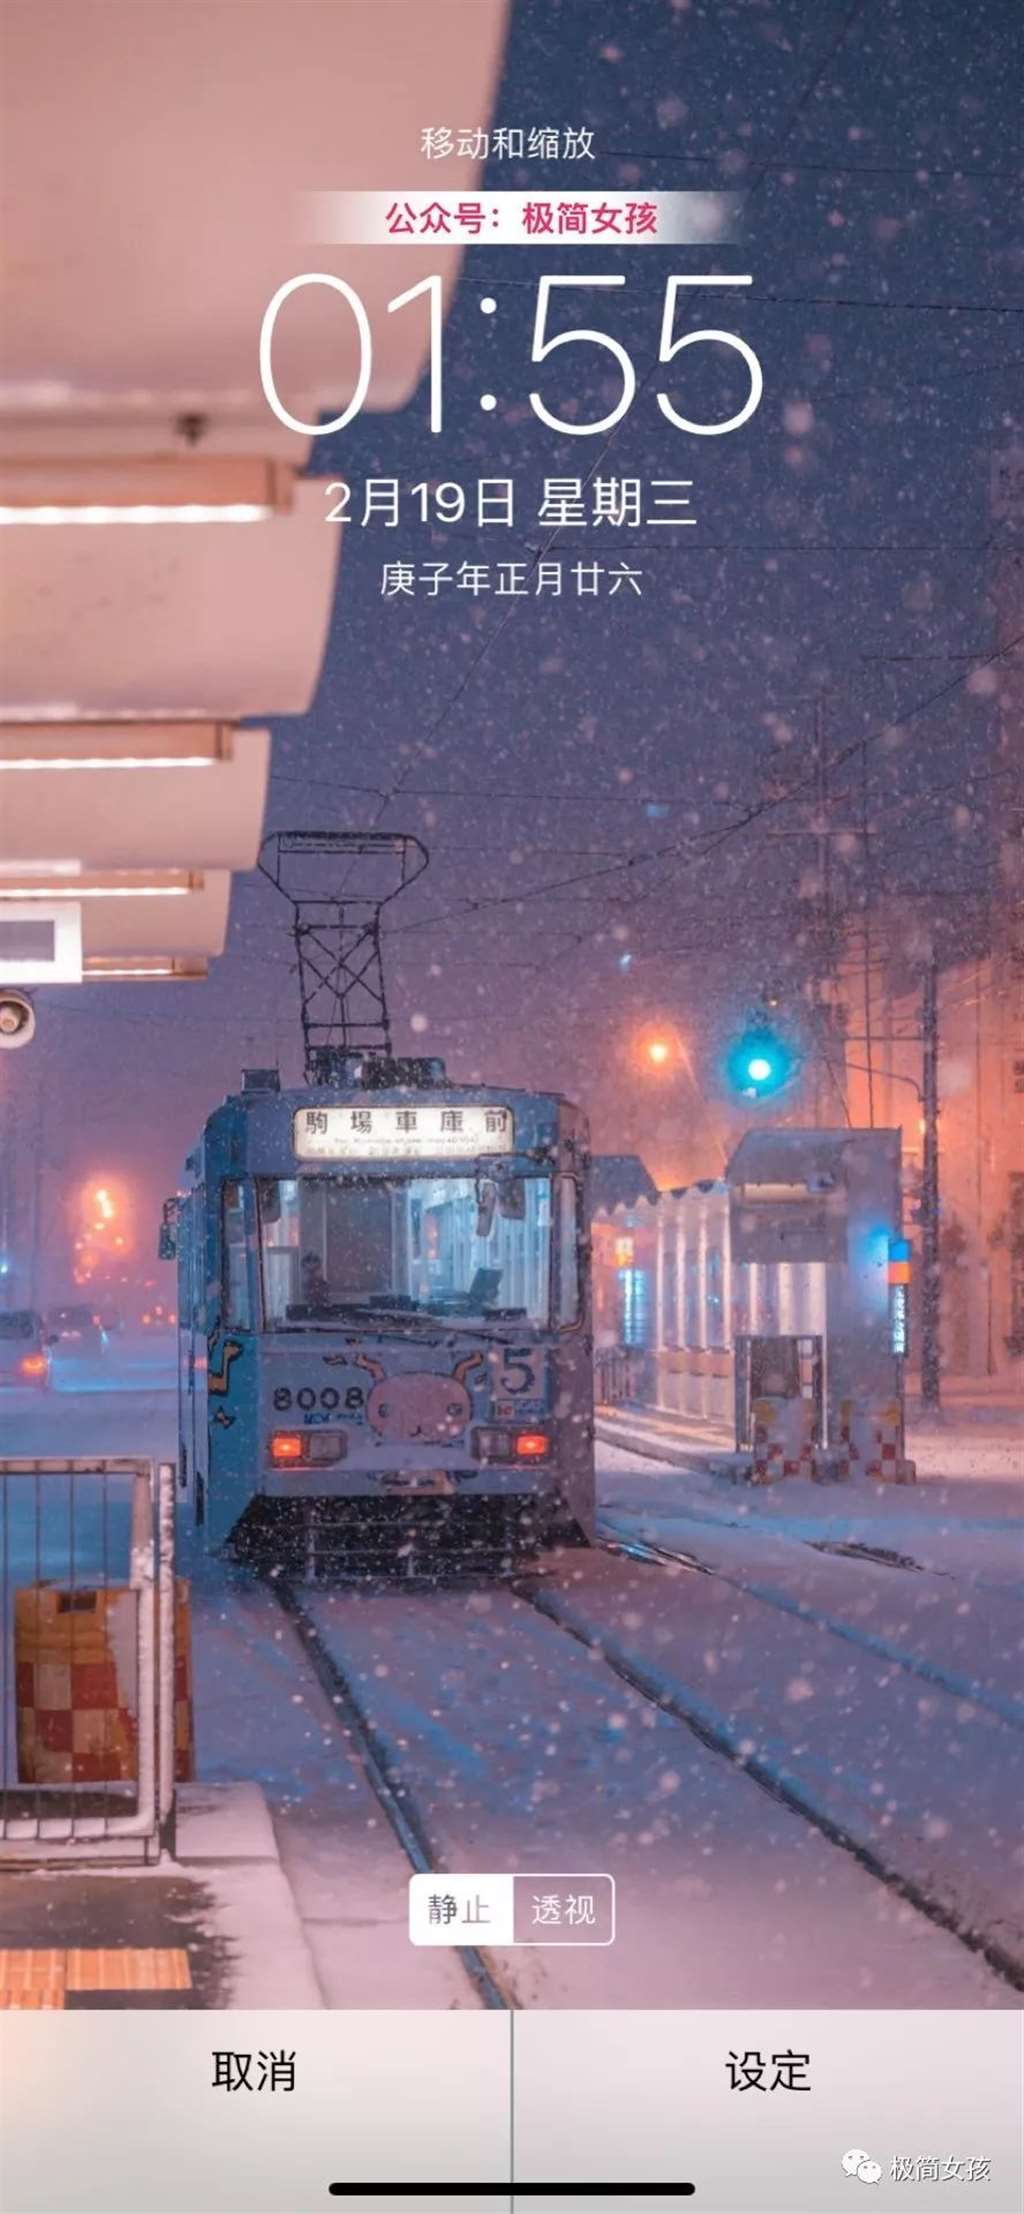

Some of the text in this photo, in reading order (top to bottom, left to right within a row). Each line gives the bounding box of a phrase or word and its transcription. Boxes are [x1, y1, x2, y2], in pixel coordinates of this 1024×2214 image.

[305, 1110, 507, 1135] 駒場車庫前
[500, 1348, 535, 1394] 5
[273, 1387, 365, 1412] 8008
